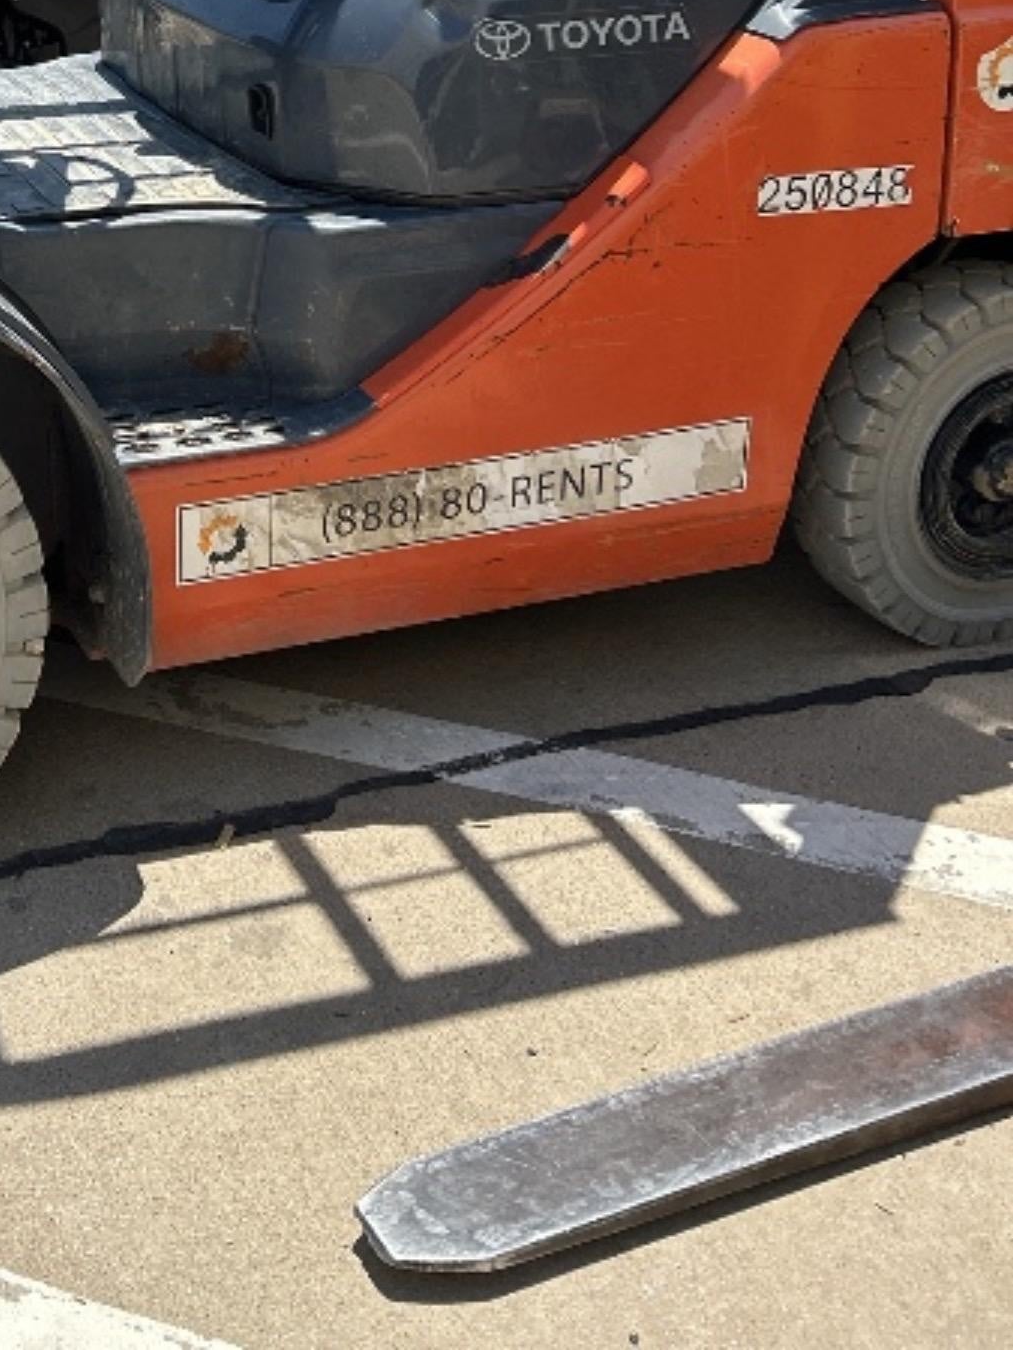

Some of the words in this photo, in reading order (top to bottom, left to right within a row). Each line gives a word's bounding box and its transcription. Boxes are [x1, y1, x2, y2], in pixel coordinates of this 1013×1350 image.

[535, 11, 690, 52] TOYOTA
[757, 166, 911, 214] 250848
[322, 491, 420, 543] (888)
[440, 458, 634, 520] 80-RENTS
